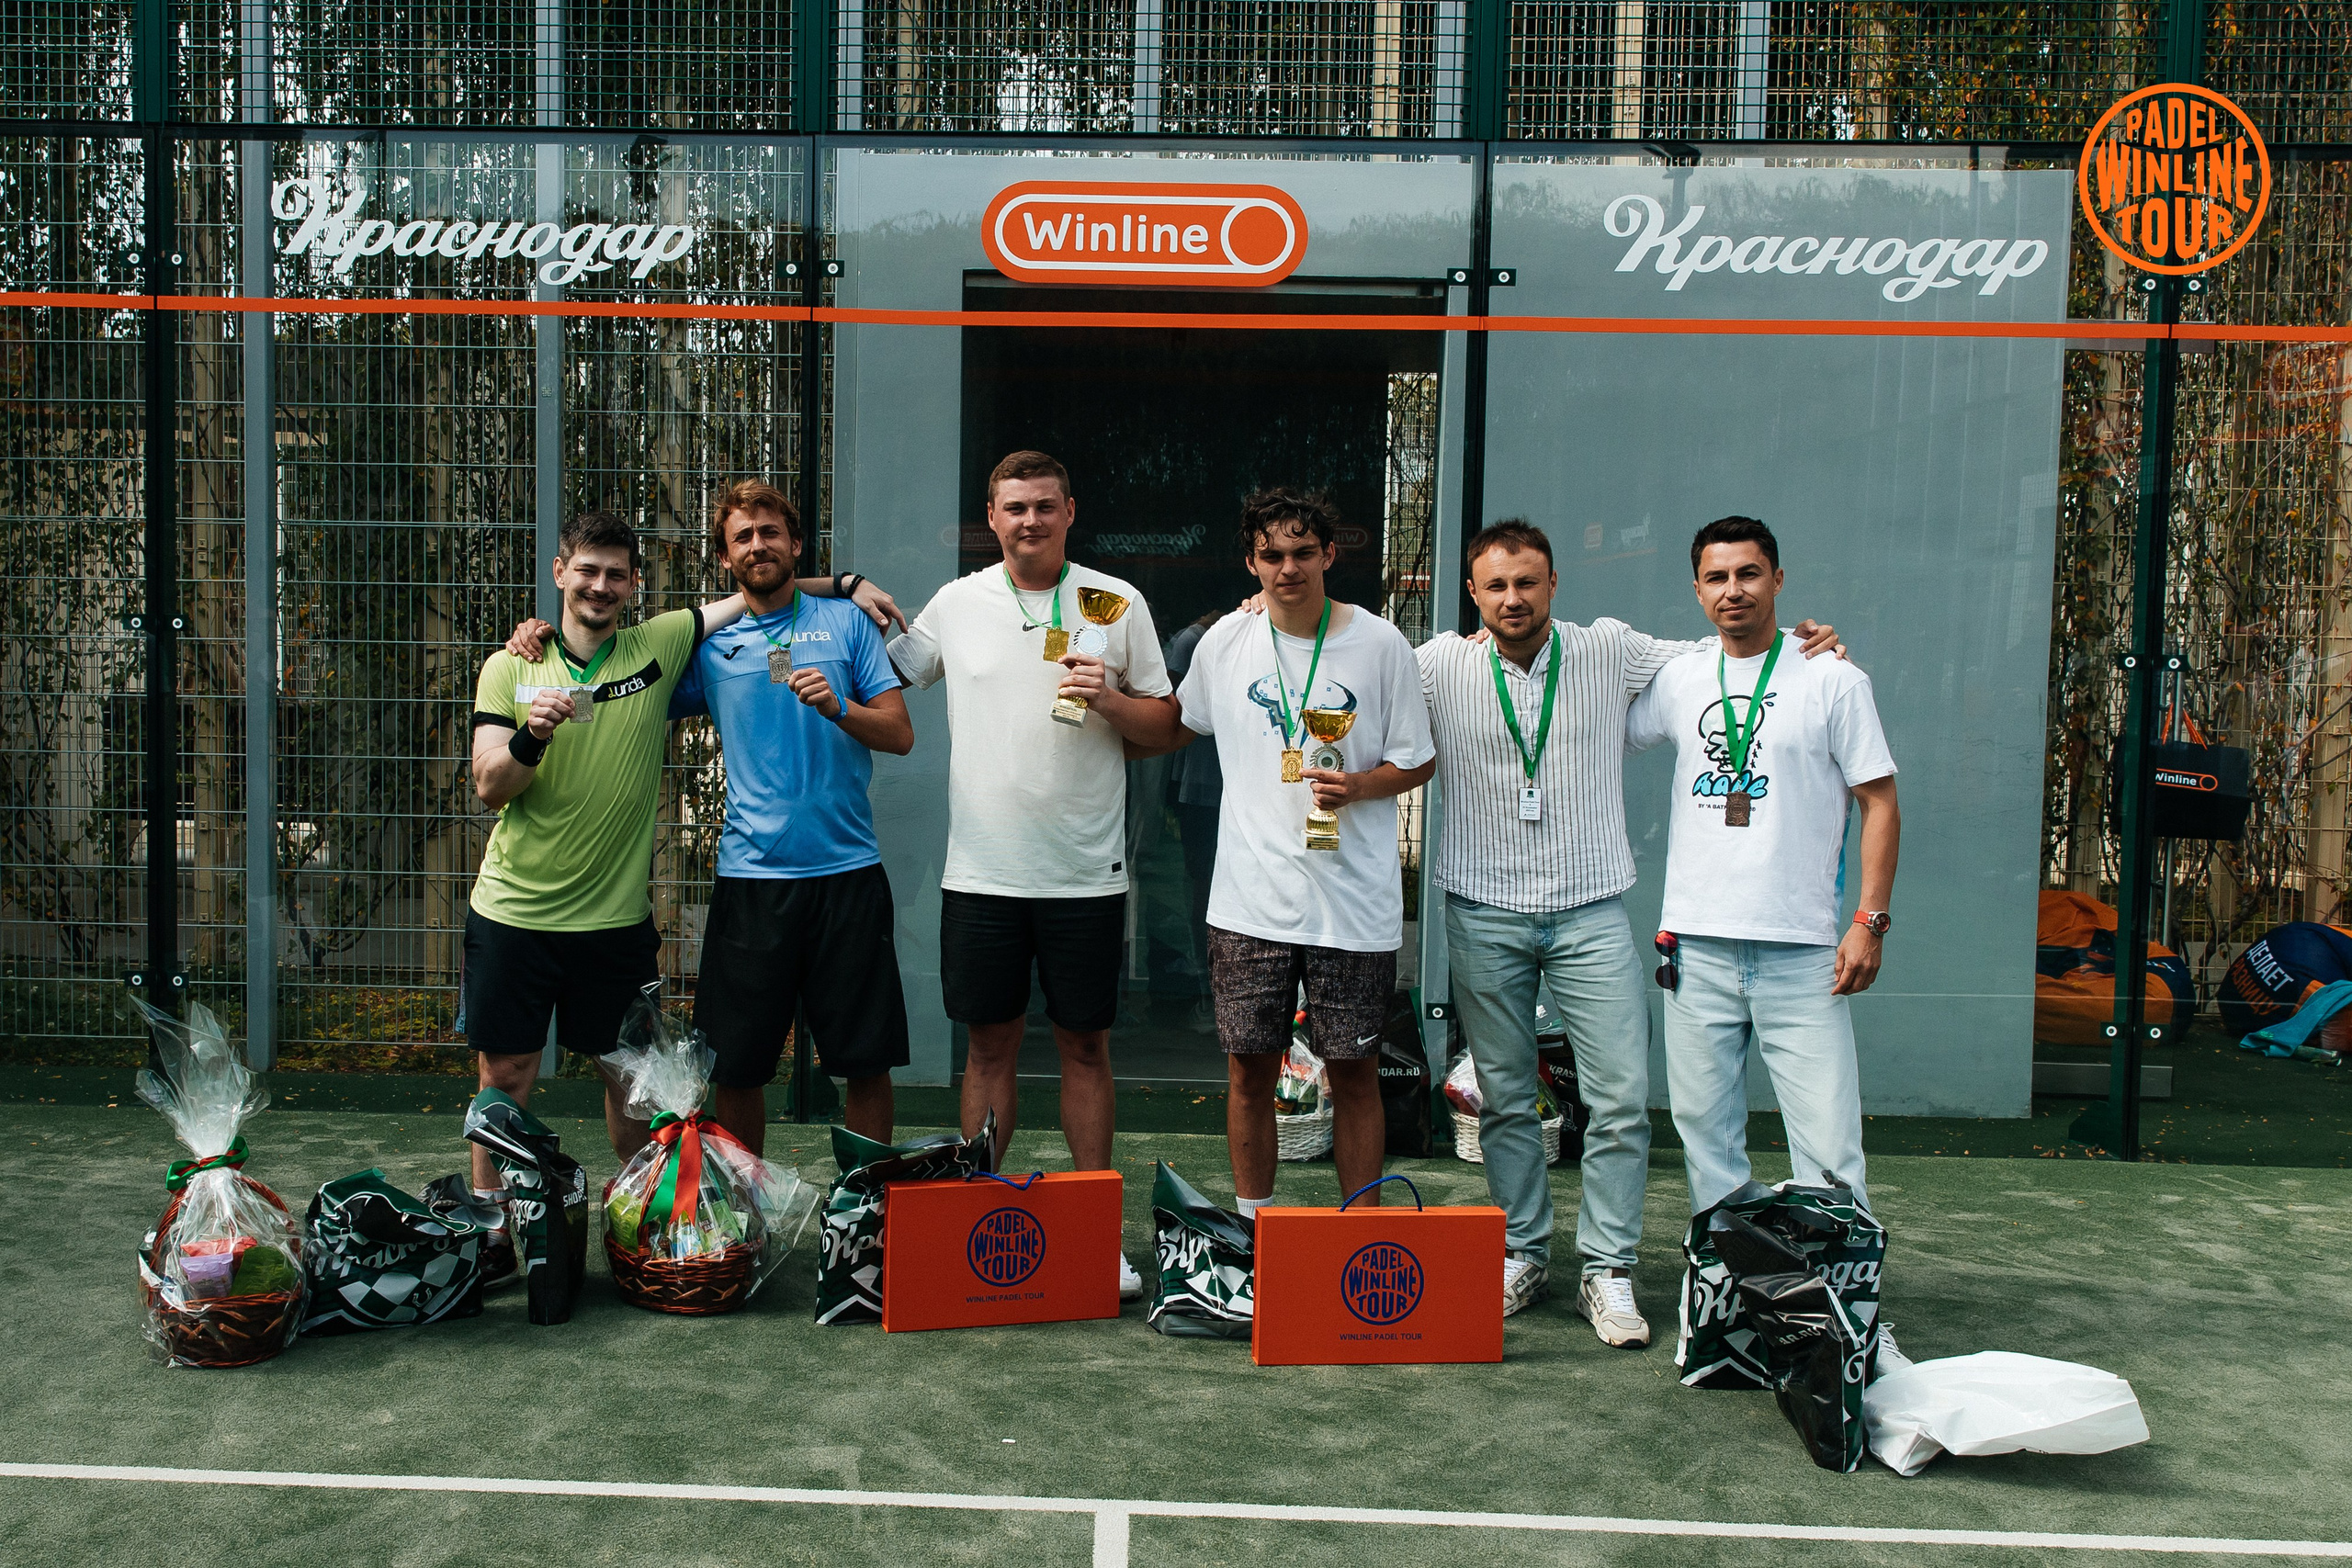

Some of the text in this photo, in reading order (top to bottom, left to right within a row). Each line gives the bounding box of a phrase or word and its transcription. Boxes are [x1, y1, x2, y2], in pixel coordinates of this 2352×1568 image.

[271, 179, 695, 286] Краснодар
[1022, 211, 1209, 254] Winline
[1602, 194, 2049, 303] Краснодар
[2246, 939, 2294, 992] ДЕЛАЕТ
[987, 1213, 1027, 1235] PADEL
[974, 1227, 1039, 1263] WINLINE
[1362, 1247, 1404, 1270] PADEL
[982, 1254, 1031, 1280] TOUR
[1348, 1264, 1417, 1299] WINLINE
[966, 1292, 1045, 1303] WINLINE PADEL TOUR
[1356, 1291, 1408, 1319] TOUR
[1340, 1333, 1422, 1341] WINLINE PADEL TOUR
